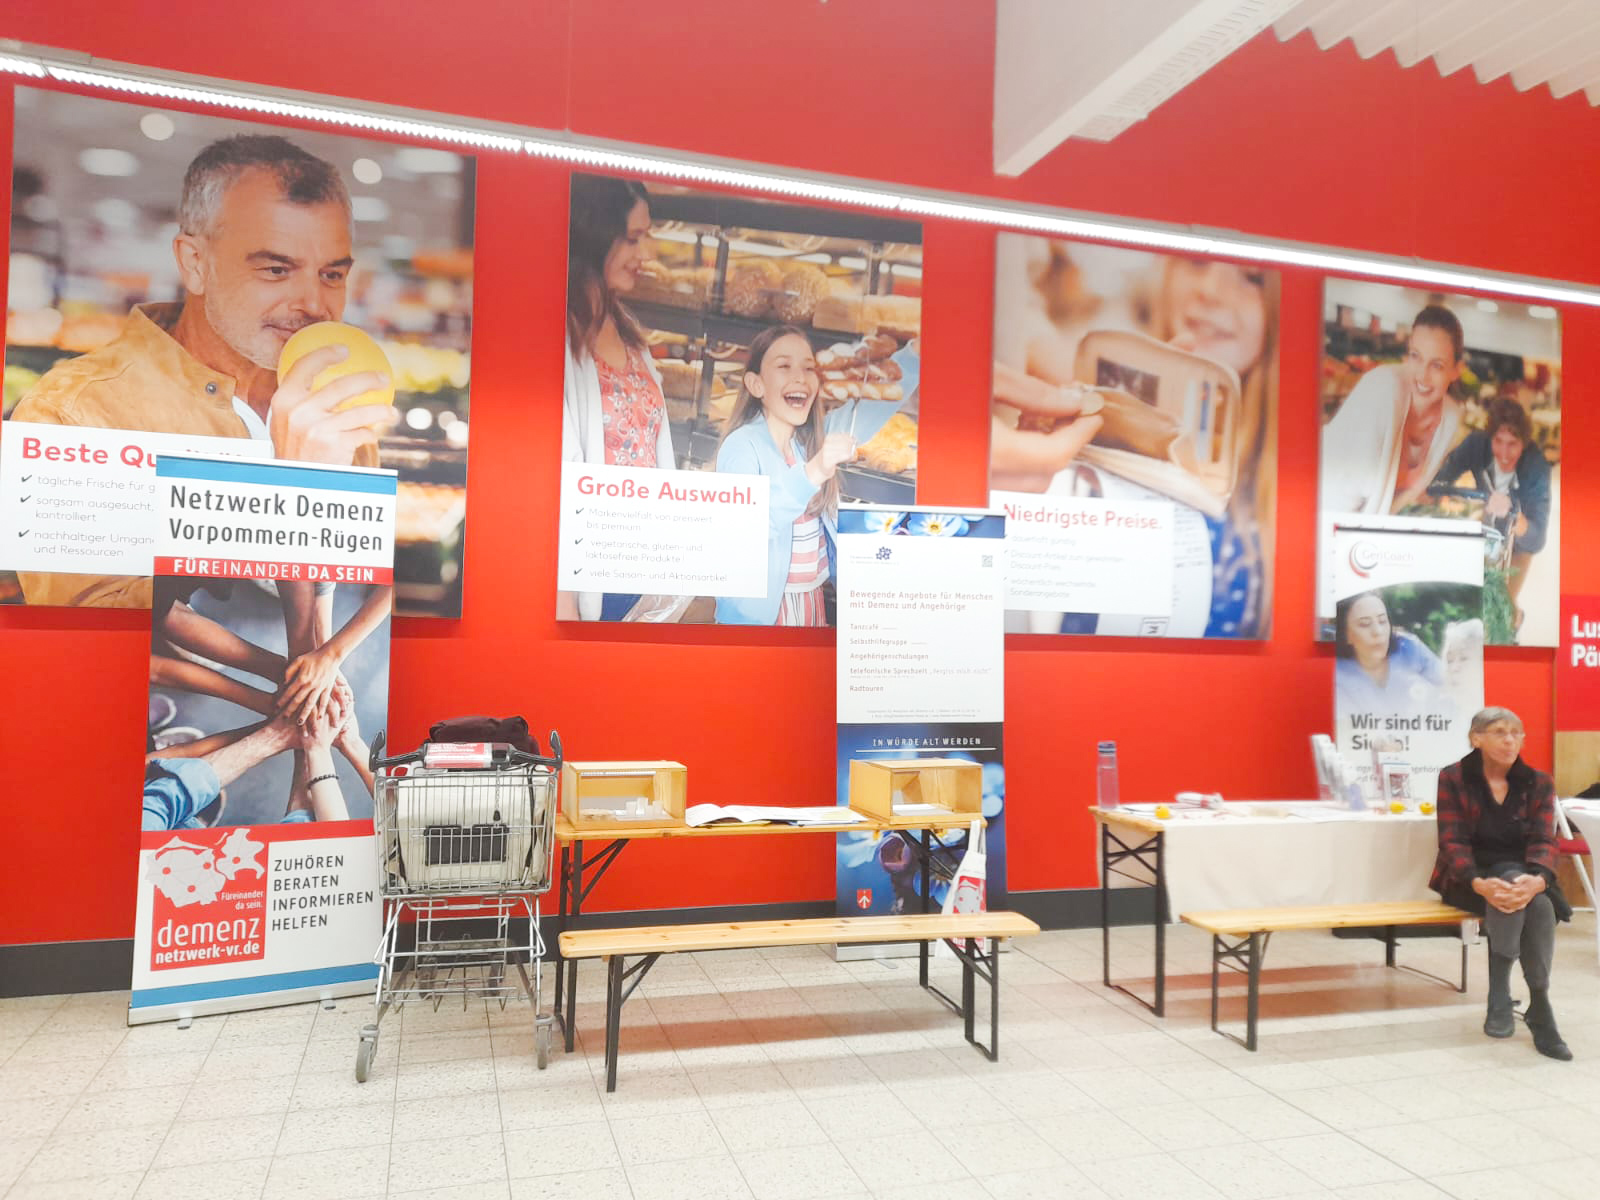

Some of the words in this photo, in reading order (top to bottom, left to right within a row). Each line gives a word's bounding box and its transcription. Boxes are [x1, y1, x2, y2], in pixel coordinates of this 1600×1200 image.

[23, 437, 108, 464] Beste
[86, 477, 125, 490] Frische
[129, 480, 144, 490] für
[577, 475, 650, 499] Große
[658, 481, 757, 505] Auswahl.
[36, 497, 84, 508] sorgsam
[87, 499, 155, 512] ausgesucht,
[170, 485, 286, 516] Netzwerk
[296, 494, 384, 522] Demenz
[35, 510, 96, 521] kontrolliert
[589, 508, 652, 520] Markenvielfalt
[1004, 503, 1098, 529] Niedrigste
[1104, 510, 1163, 529] Preise.
[586, 521, 599, 529] bis
[601, 523, 641, 532] premium
[34, 530, 106, 544] nachhaltiger
[169, 518, 382, 553] Vorpommern-Rügen
[34, 545, 56, 554] und
[60, 545, 124, 557] Ressourcen
[686, 543, 703, 552] und
[173, 557, 301, 579] FÜREINANDER
[308, 565, 330, 580] DA
[335, 567, 374, 582] SEIN
[589, 568, 611, 578] viele
[649, 571, 666, 580] und
[668, 571, 728, 582] Aktionsartikel
[849, 590, 896, 601] Bewegende
[899, 591, 938, 601] Angebote
[955, 592, 993, 601] Menschen
[849, 601, 865, 609] mit
[867, 601, 899, 610] Demenz
[902, 601, 917, 610] und
[920, 602, 966, 612] Angehörige
[849, 685, 884, 693] Radtouren
[1350, 712, 1382, 730] Wir
[1385, 713, 1421, 731] sind
[1425, 714, 1452, 731] für
[872, 738, 884, 747] IN
[886, 736, 920, 747] WÜRDE
[922, 738, 940, 746] ALT
[942, 737, 981, 746] WERDEN
[274, 854, 344, 872] ZUHÖREN
[273, 875, 340, 892] BERATEN
[221, 890, 264, 900] Füreinander
[273, 890, 374, 911] INFORMIEREN
[235, 901, 245, 910] da
[246, 900, 264, 910] sein.
[272, 914, 328, 931] HELFEN
[157, 917, 260, 948] demenz
[155, 940, 260, 965] netzwerk-vr.de
